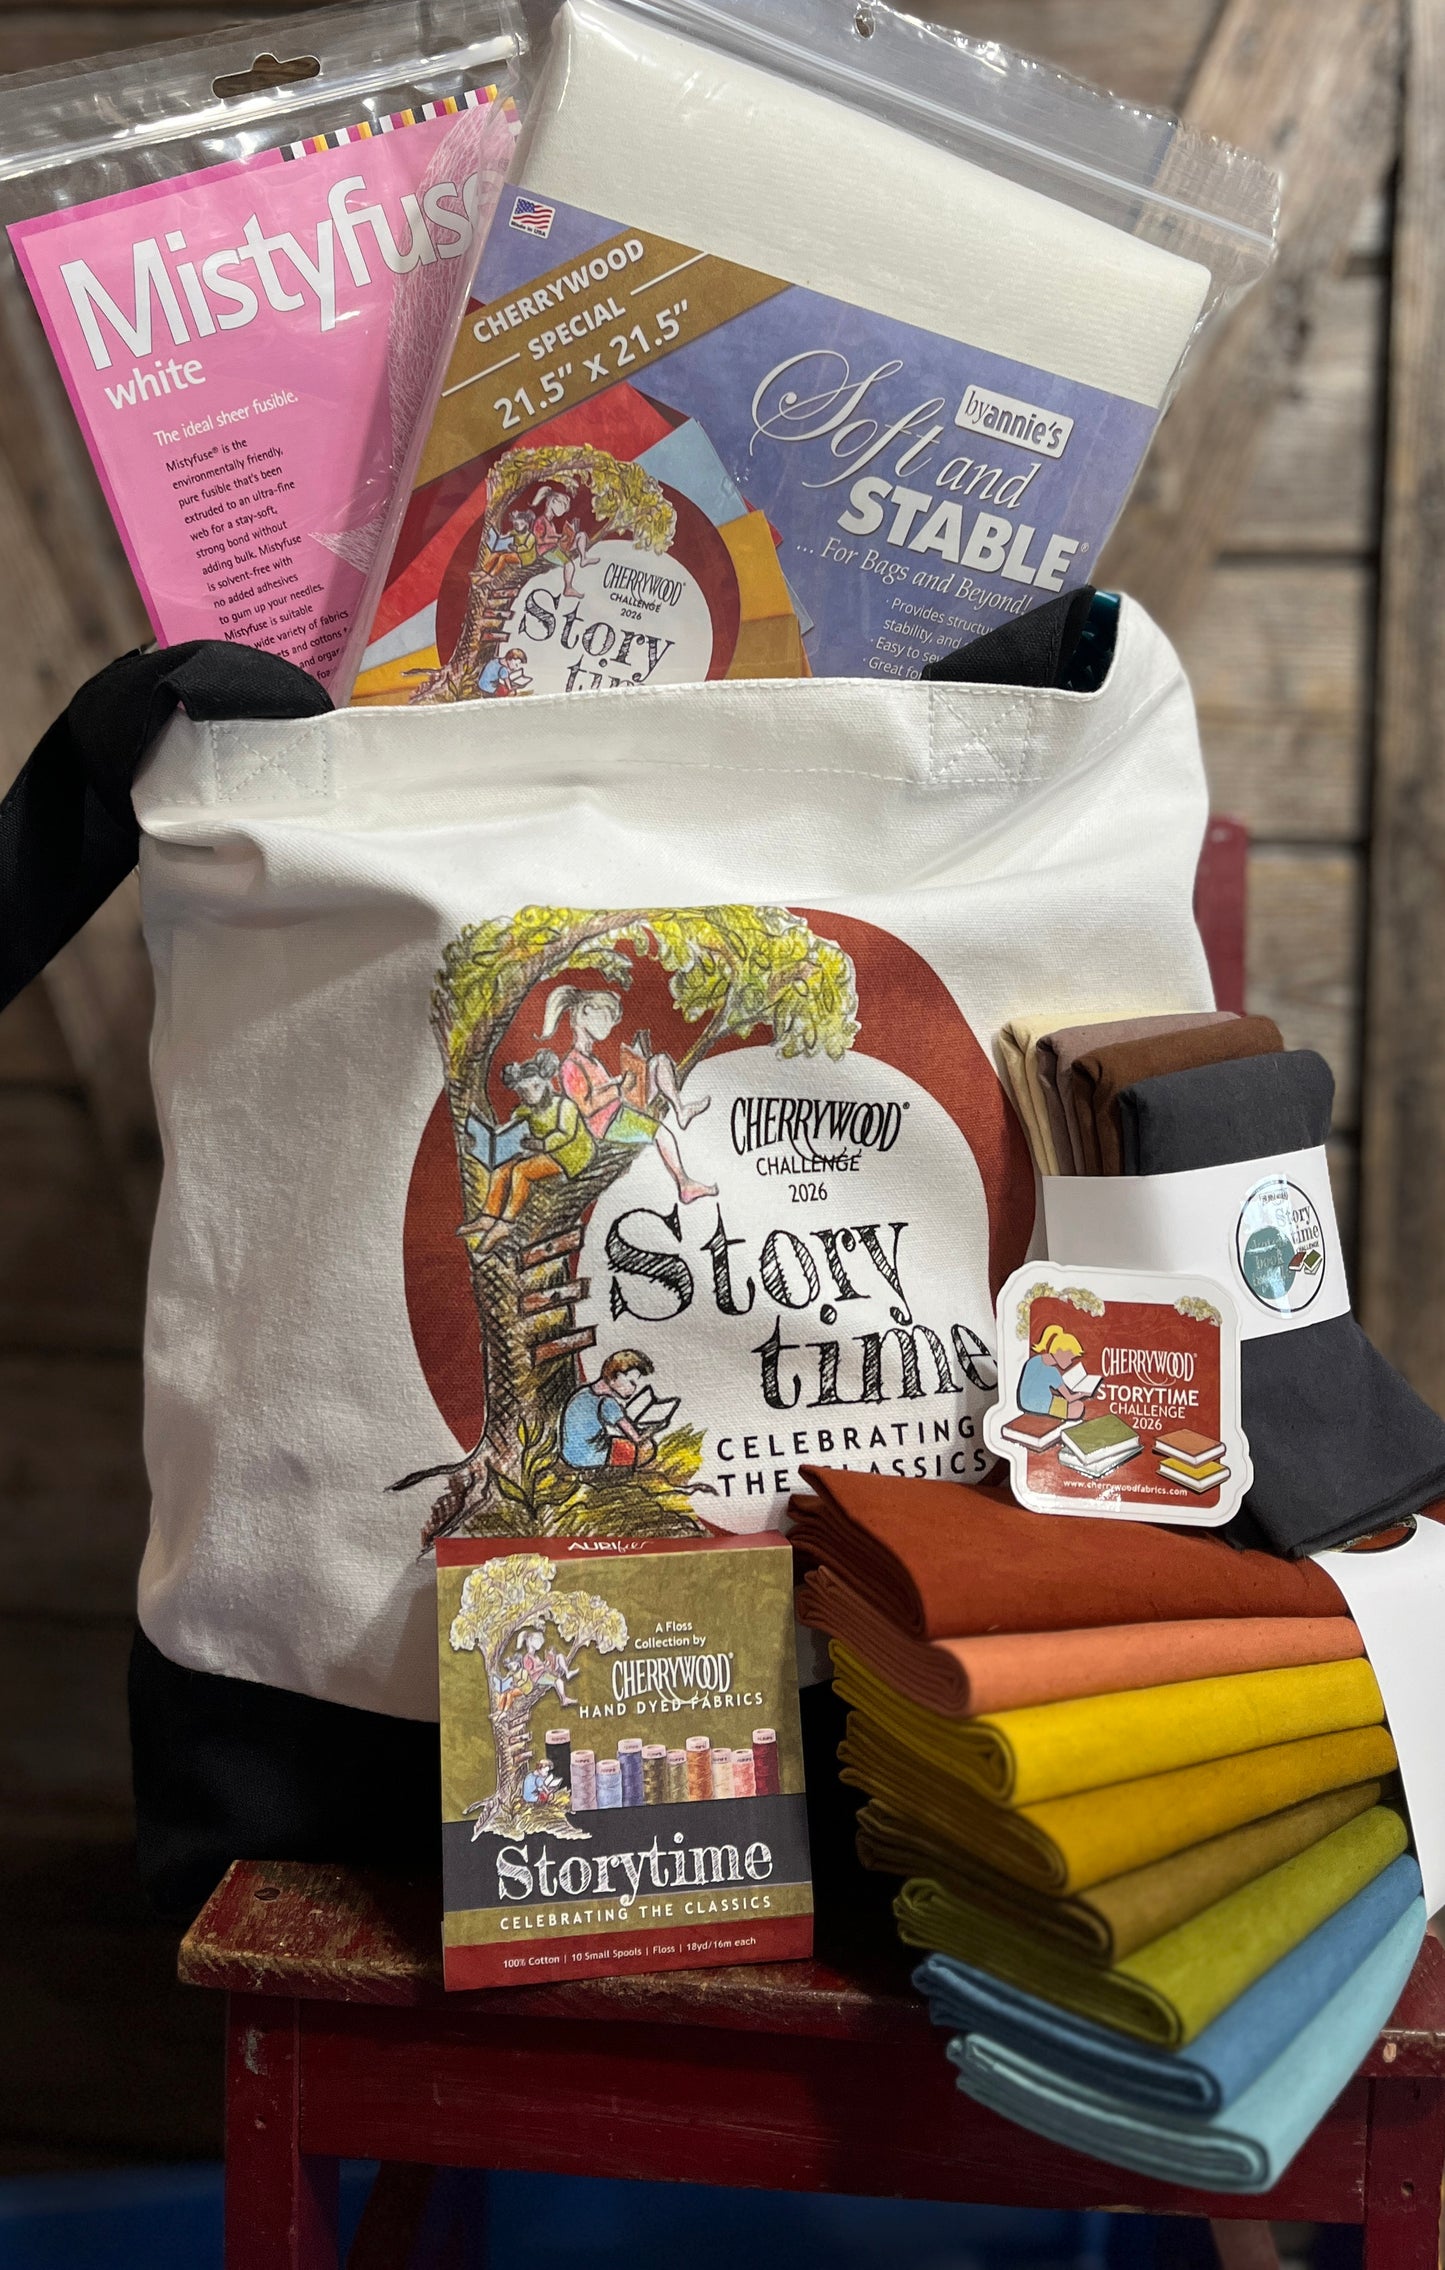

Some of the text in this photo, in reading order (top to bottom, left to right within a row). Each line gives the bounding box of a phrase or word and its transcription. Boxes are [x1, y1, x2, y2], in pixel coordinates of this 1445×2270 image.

[533, 228, 546, 237] USA
[472, 239, 645, 343] CHERRYWOOD
[528, 297, 626, 361] SPECIAL
[104, 358, 206, 410] white
[153, 389, 299, 447] The ideal sheer fusible.
[750, 350, 1041, 509] Soft and
[221, 443, 231, 454] is
[232, 438, 249, 451] the
[172, 446, 284, 490] environmentally friendly,
[178, 465, 283, 510] pure fusible that's been
[184, 480, 296, 525] extruded to an ultra-fine
[189, 504, 279, 542] web for a stay-soft,
[196, 520, 288, 559] strong bond without
[202, 535, 302, 576] adding bulk. Mistyfuse
[207, 556, 294, 592] is solvent-free with
[213, 573, 299, 609] no added adhesives
[820, 537, 860, 565] For
[860, 550, 909, 585] Bags
[912, 568, 955, 595] and
[954, 579, 1033, 618] Beyond!
[219, 582, 325, 625] to gum up your needles.
[609, 592, 662, 613] CHALLENGE
[620, 607, 642, 621] 2026
[890, 597, 944, 624] Provides
[224, 604, 314, 641] Mistyfuse is suitable
[253, 608, 349, 650] wide variety of fabrics
[518, 588, 675, 683] Story
[883, 619, 962, 650] stability, and
[292, 642, 308, 654] and
[310, 630, 342, 648] cottons
[875, 636, 905, 658] Easy
[906, 646, 919, 658] to
[299, 657, 316, 669] and
[868, 656, 902, 676] Great
[756, 1153, 860, 1176] CHALLENGE
[788, 1182, 828, 1203] 2026
[605, 1203, 913, 1324] Story
[751, 1304, 998, 1409] time
[1097, 1384, 1199, 1407] STORYTIME
[1109, 1402, 1186, 1419] CHALLENGE
[717, 1416, 976, 1462] CELEBRATING
[1132, 1417, 1163, 1431] 2026
[717, 1469, 791, 1497] THE
[1063, 1479, 1188, 1497] www.cherrywoodfabrics.com
[635, 1634, 707, 1650] Collection by
[655, 1620, 693, 1633] A Floss
[579, 1692, 763, 1719] HAND DYED FABRICS
[495, 1833, 773, 1907] Storytime
[500, 1895, 772, 1930] CELEBRATING THE CLASSICS
[503, 1937, 756, 1968] 100% Cotton 10 Small Spools Floss 18yd/16m each
